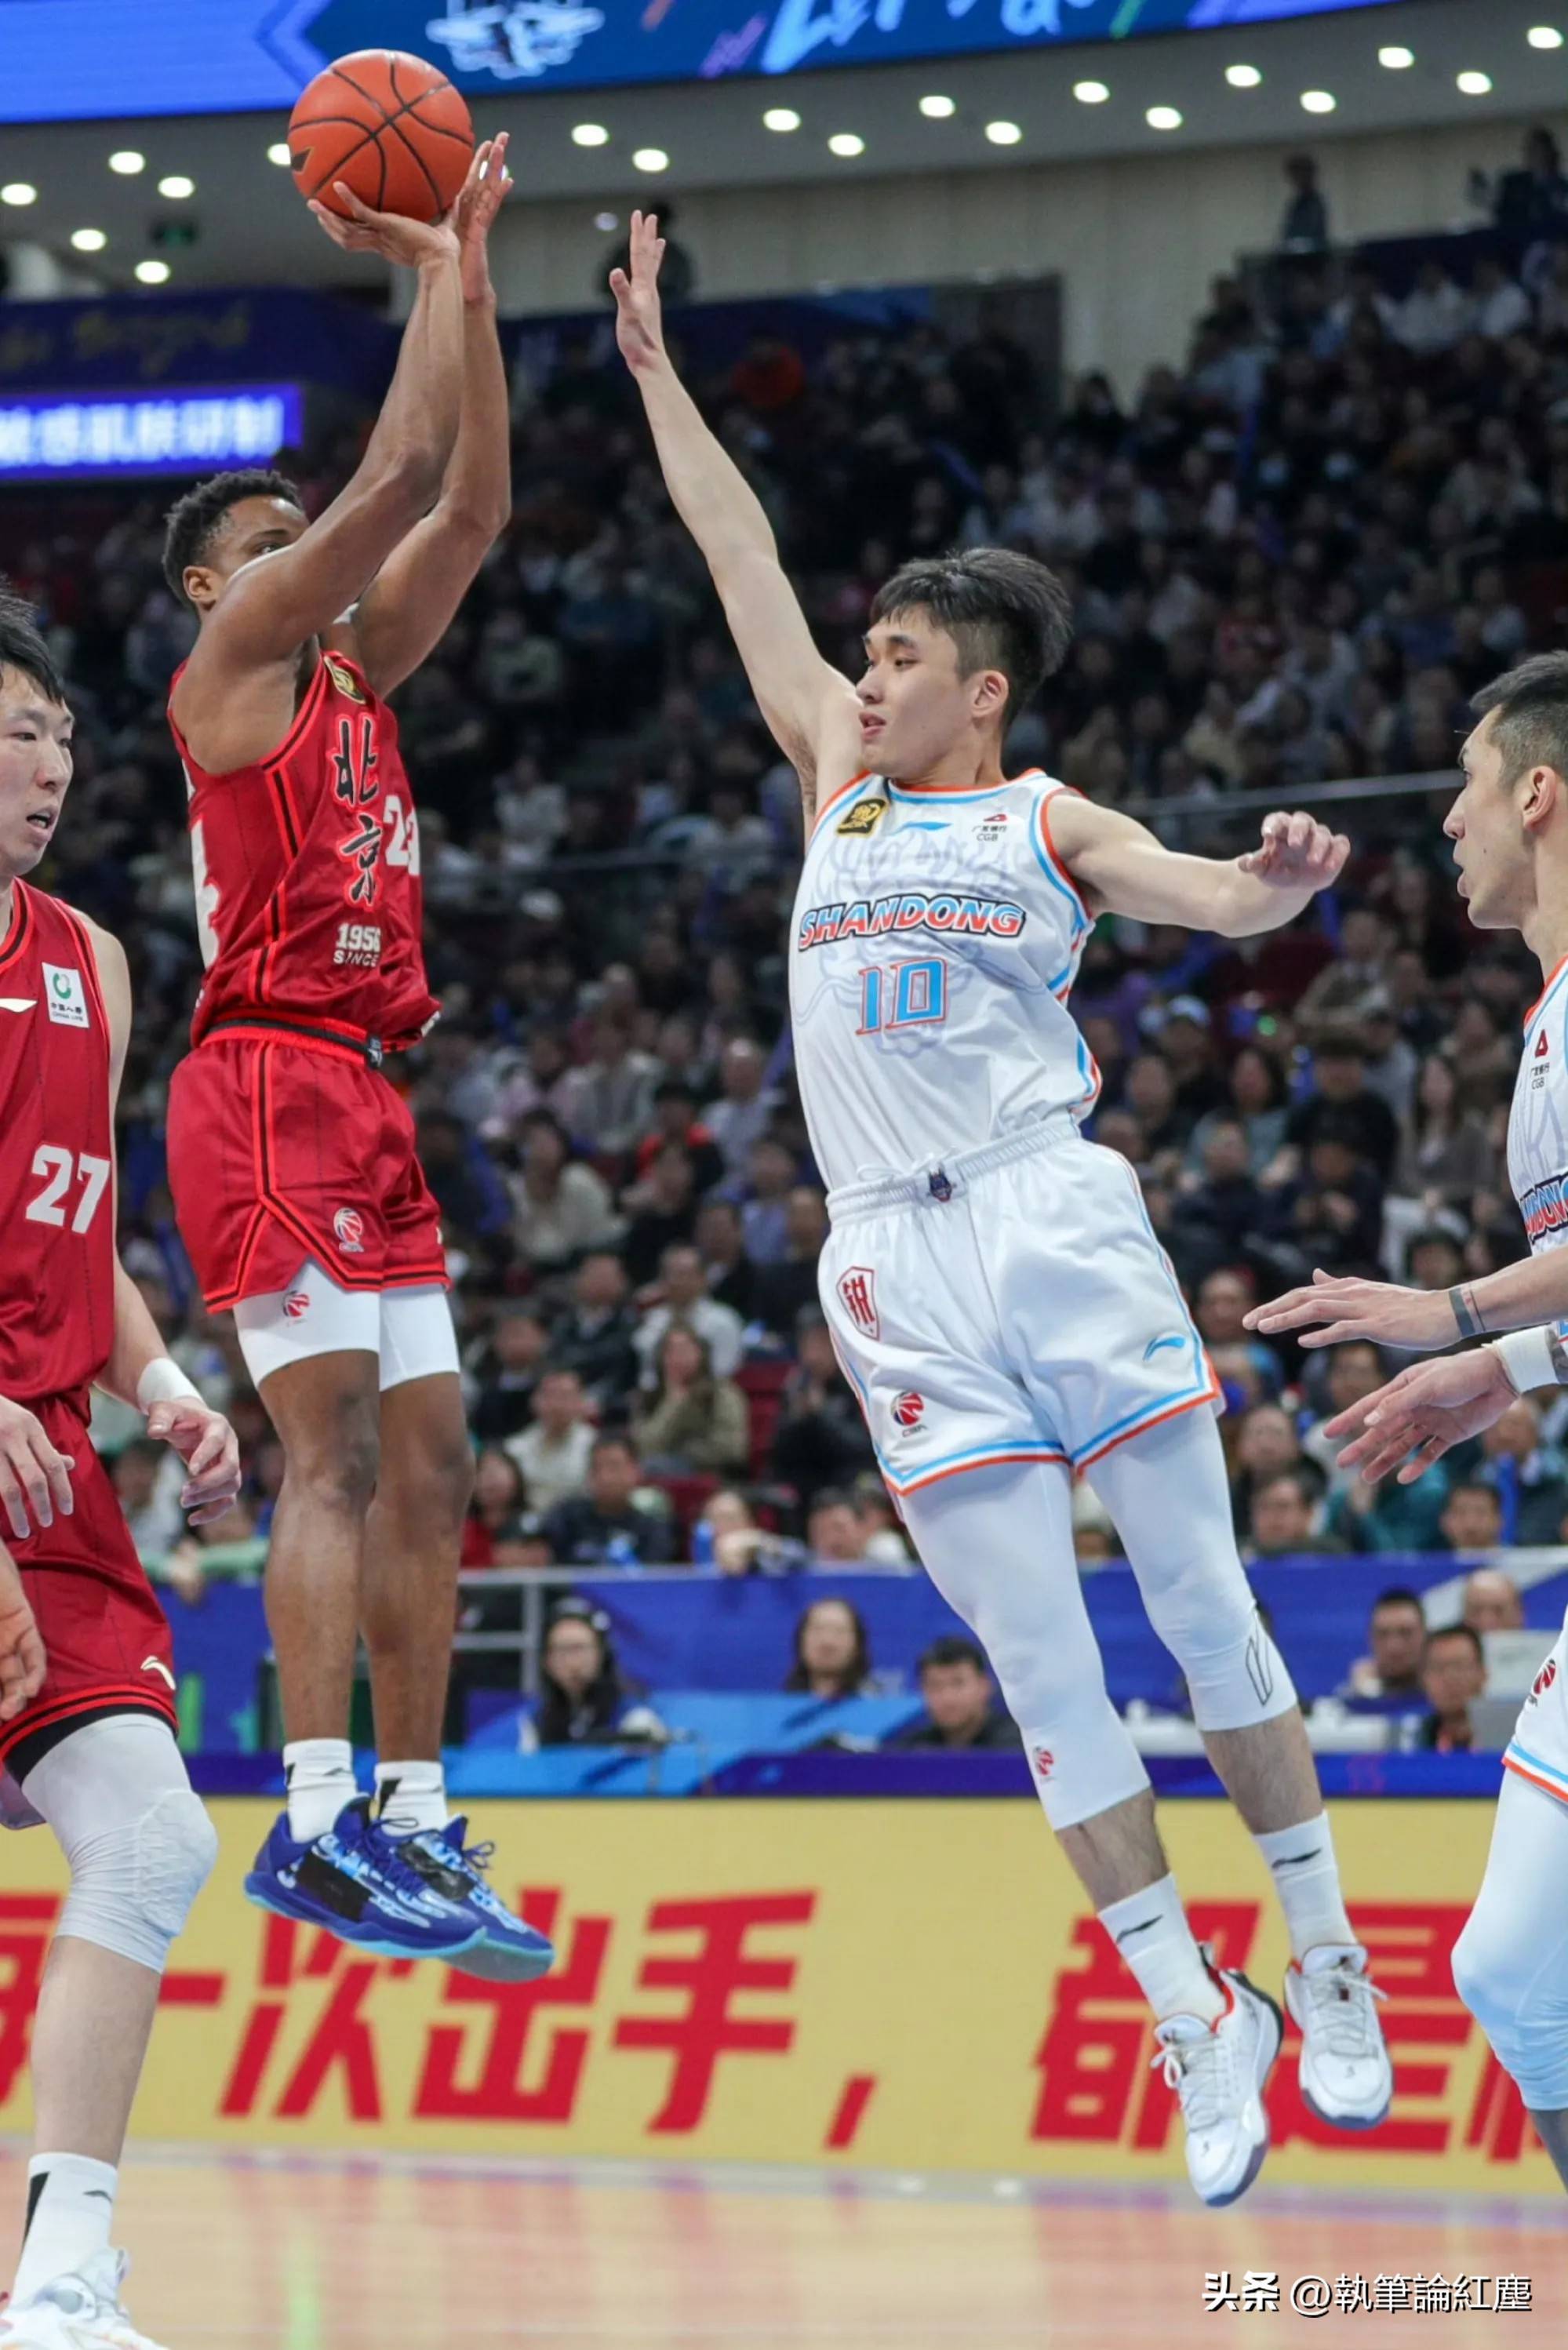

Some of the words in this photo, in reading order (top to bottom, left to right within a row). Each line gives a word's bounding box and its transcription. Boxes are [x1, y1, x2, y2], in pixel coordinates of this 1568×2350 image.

[329, 714, 382, 908] 北京
[333, 950, 380, 968] SINCE
[799, 893, 1026, 951] SHANDONG
[856, 956, 948, 1035] 10
[26, 1144, 111, 1235] 27
